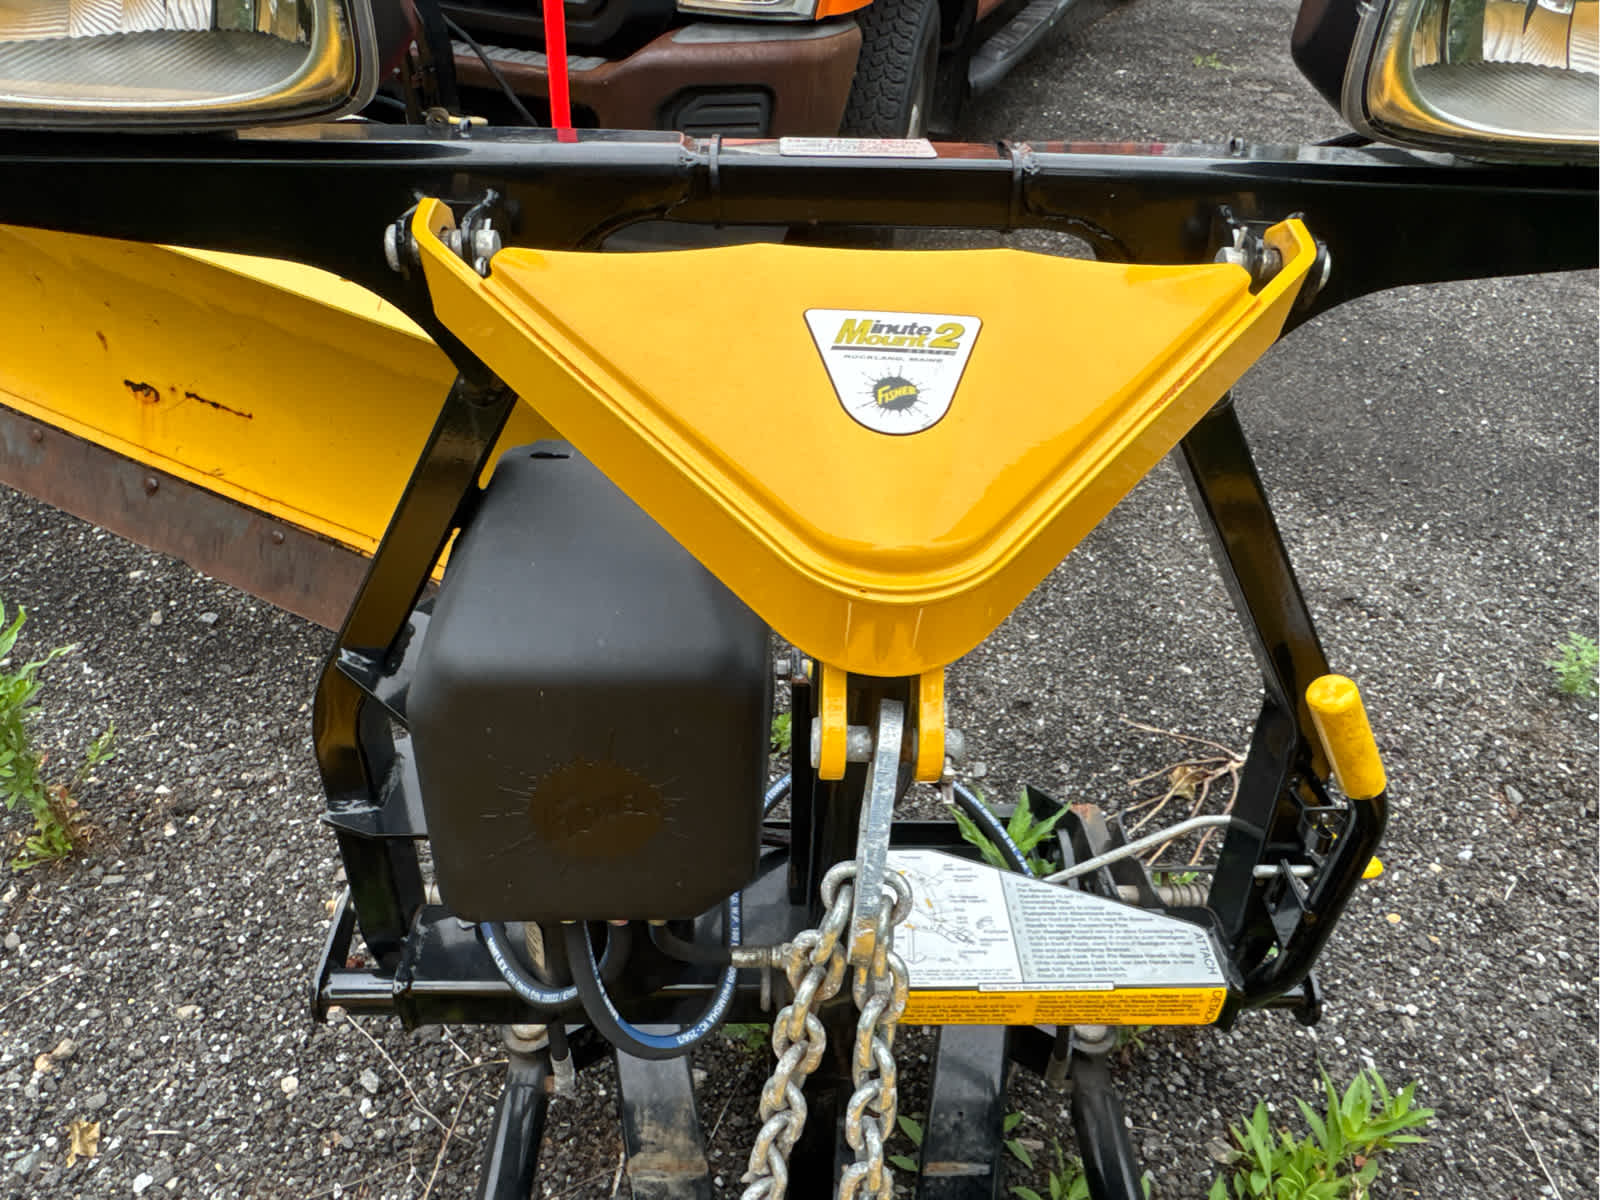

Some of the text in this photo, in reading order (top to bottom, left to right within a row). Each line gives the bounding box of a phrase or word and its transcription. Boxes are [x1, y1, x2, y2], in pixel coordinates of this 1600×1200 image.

[834, 318, 932, 345] Minute
[928, 322, 965, 349] 2
[1193, 931, 1219, 975] ATTACH
